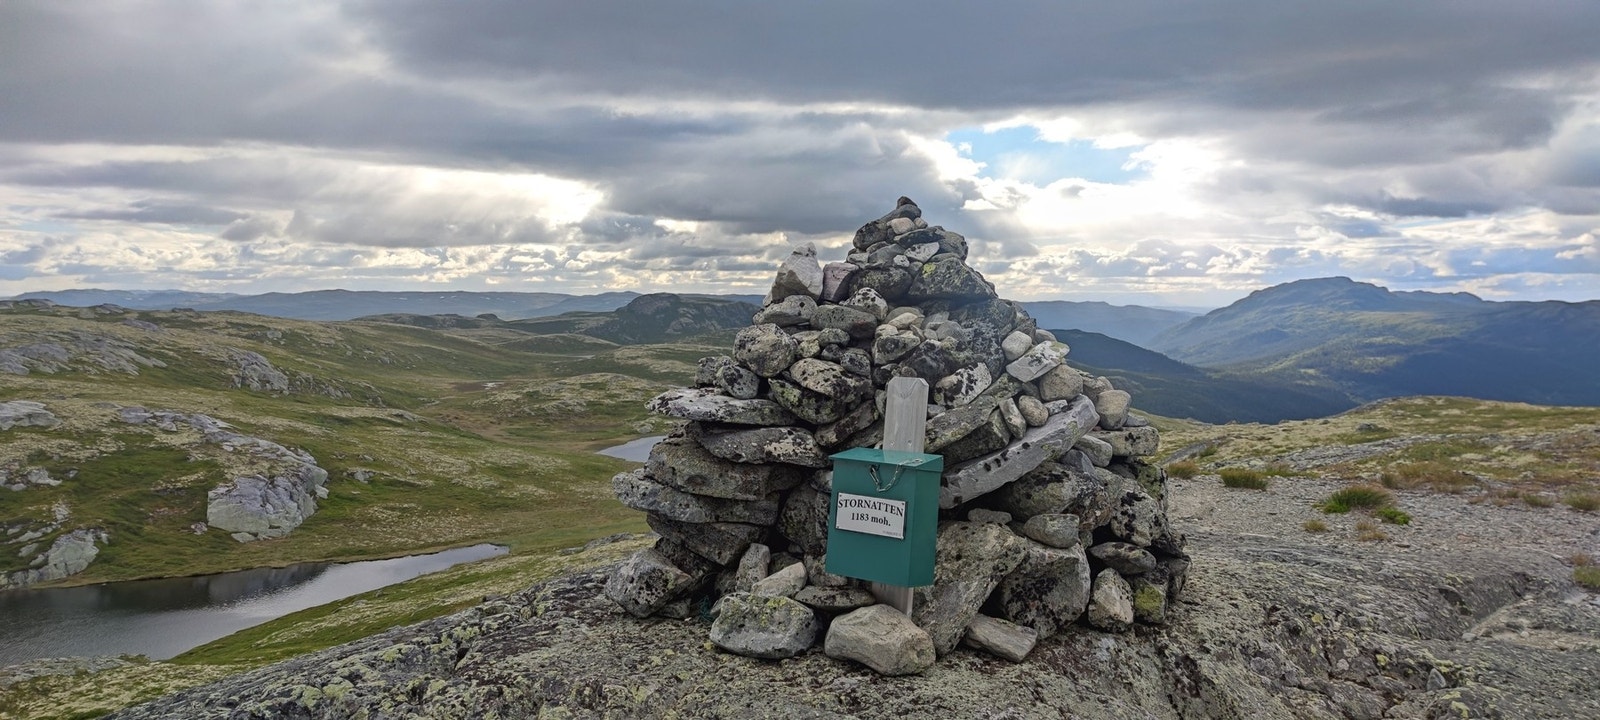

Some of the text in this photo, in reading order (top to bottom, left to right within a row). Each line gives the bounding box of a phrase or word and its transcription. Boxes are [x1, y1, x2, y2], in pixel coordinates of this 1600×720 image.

[838, 498, 904, 517] STORNATTEN
[851, 512, 891, 526] 1183 moh.
